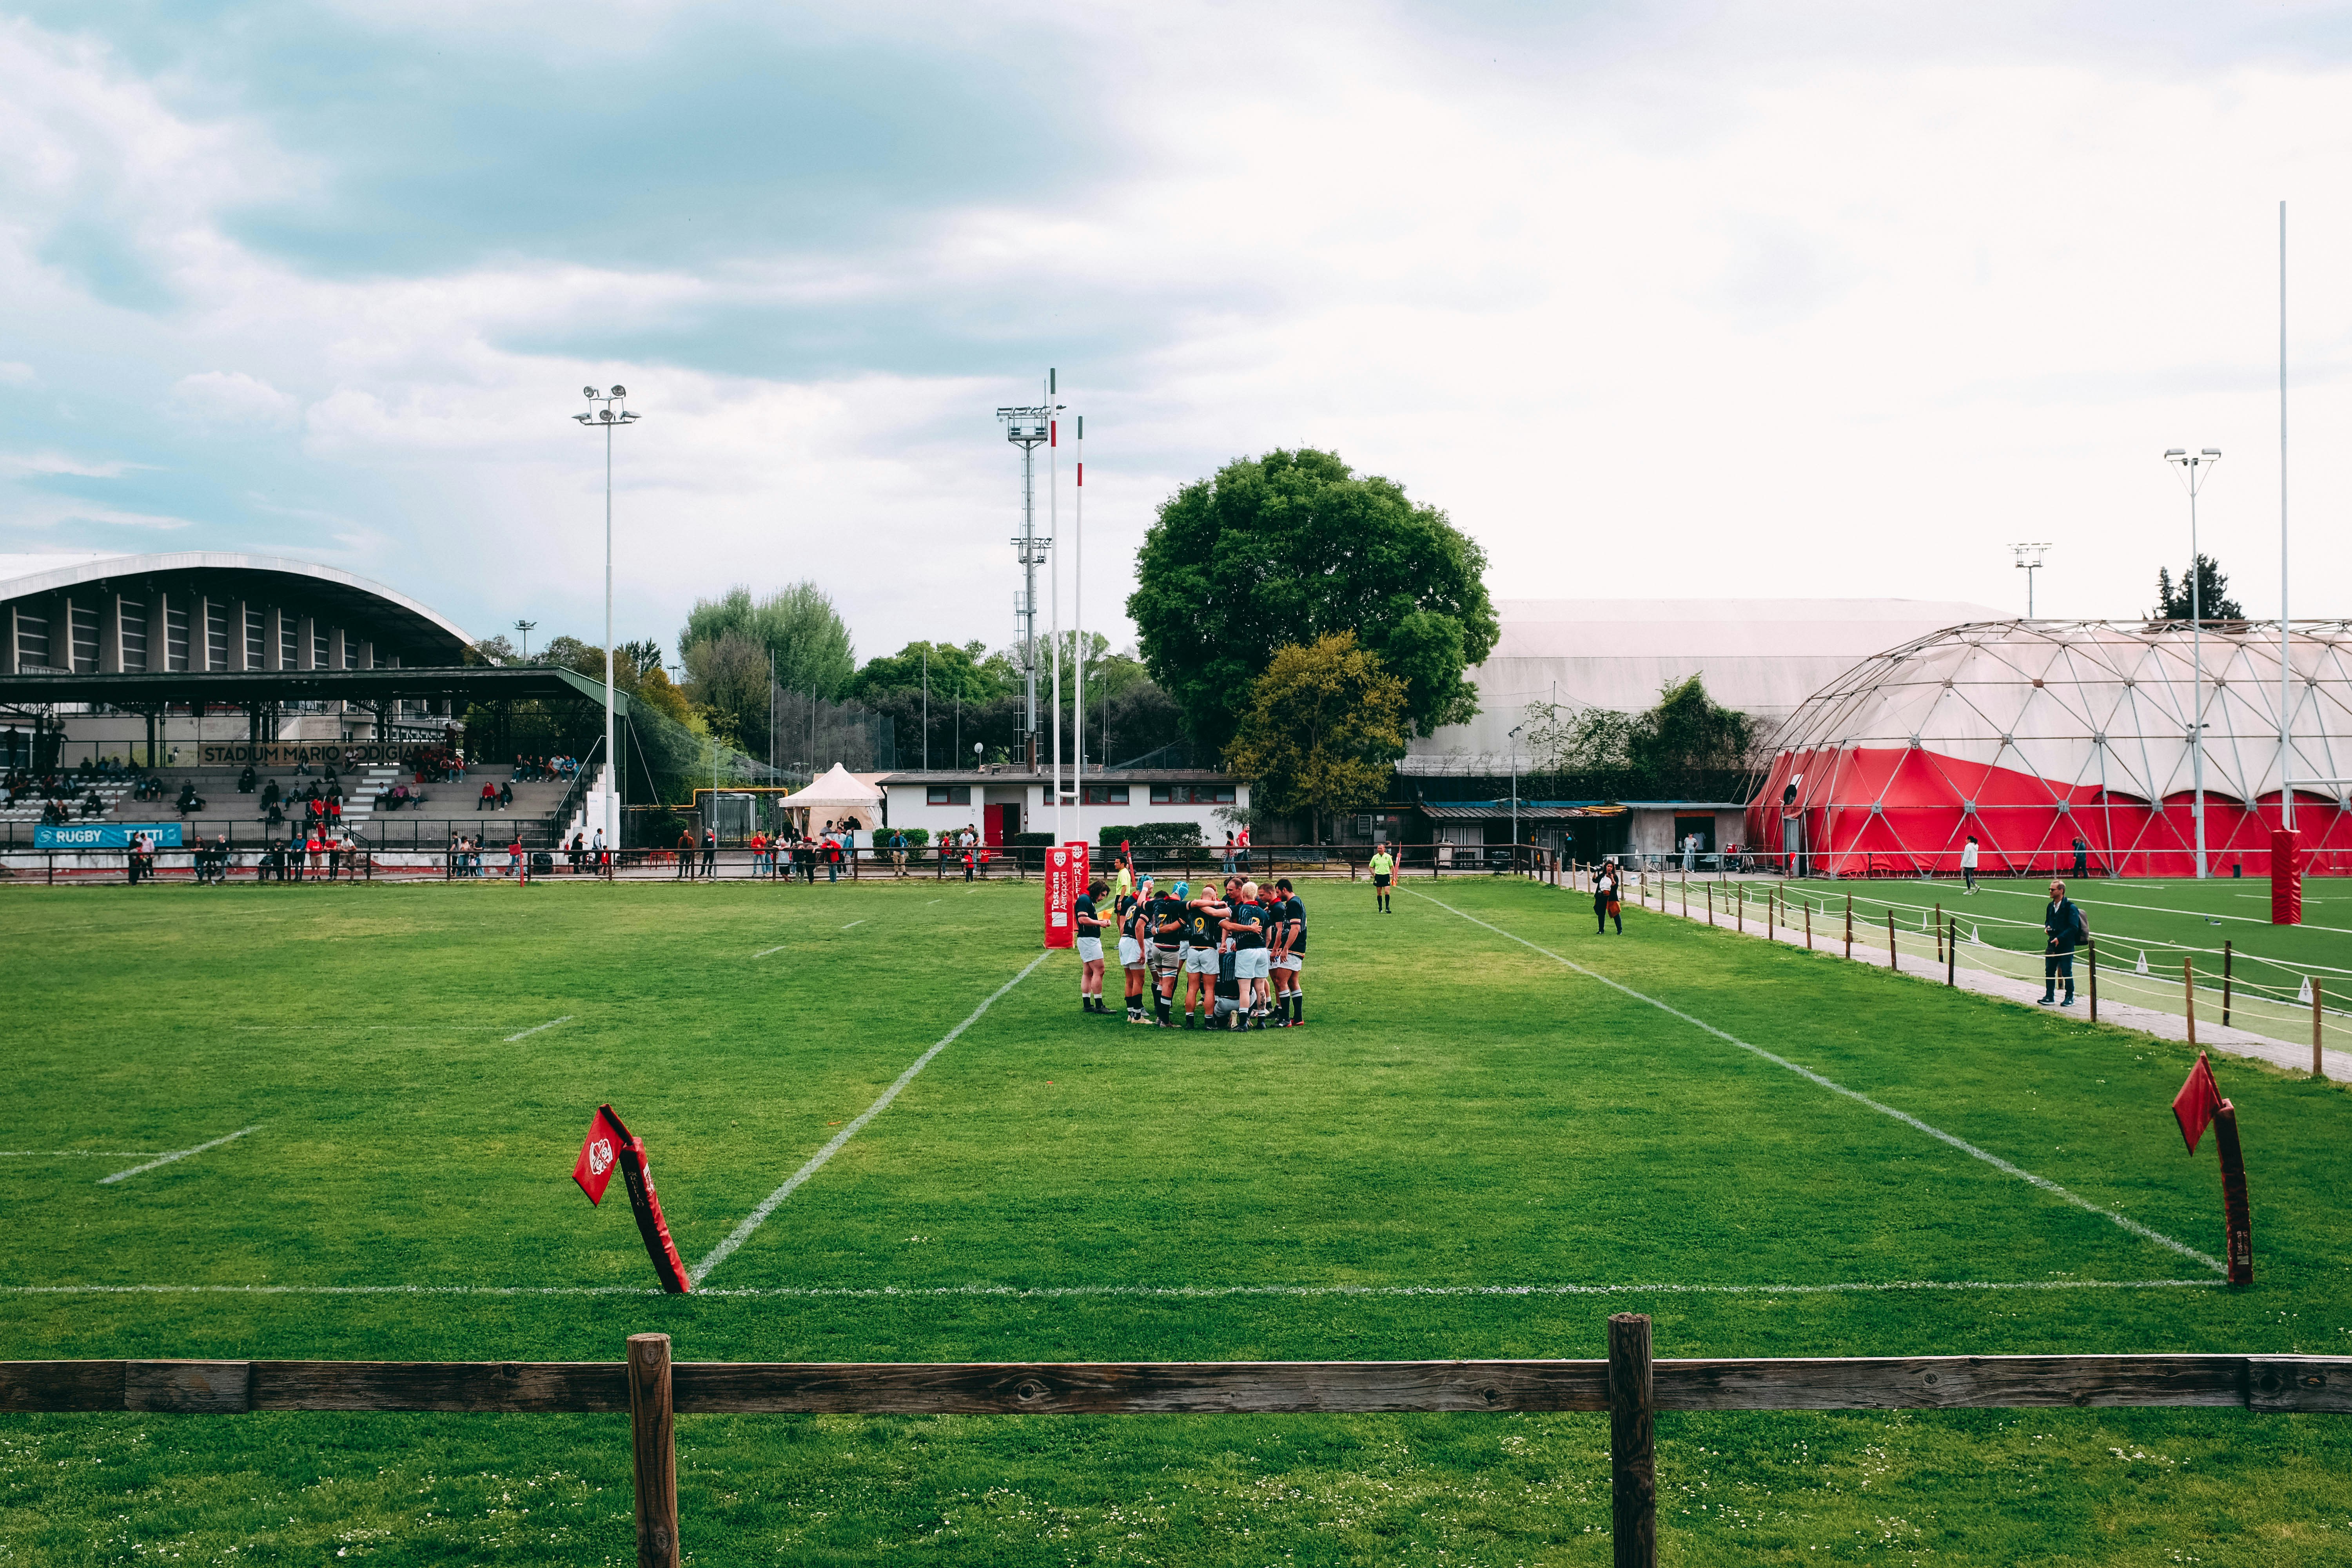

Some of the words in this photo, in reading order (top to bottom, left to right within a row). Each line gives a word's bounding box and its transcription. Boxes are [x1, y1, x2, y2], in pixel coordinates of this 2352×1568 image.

[205, 746, 278, 761] STADIUM
[284, 746, 340, 760] MARIO
[56, 830, 102, 843] RUGBY
[1158, 914, 1167, 927] 7
[1194, 917, 1205, 933] 9
